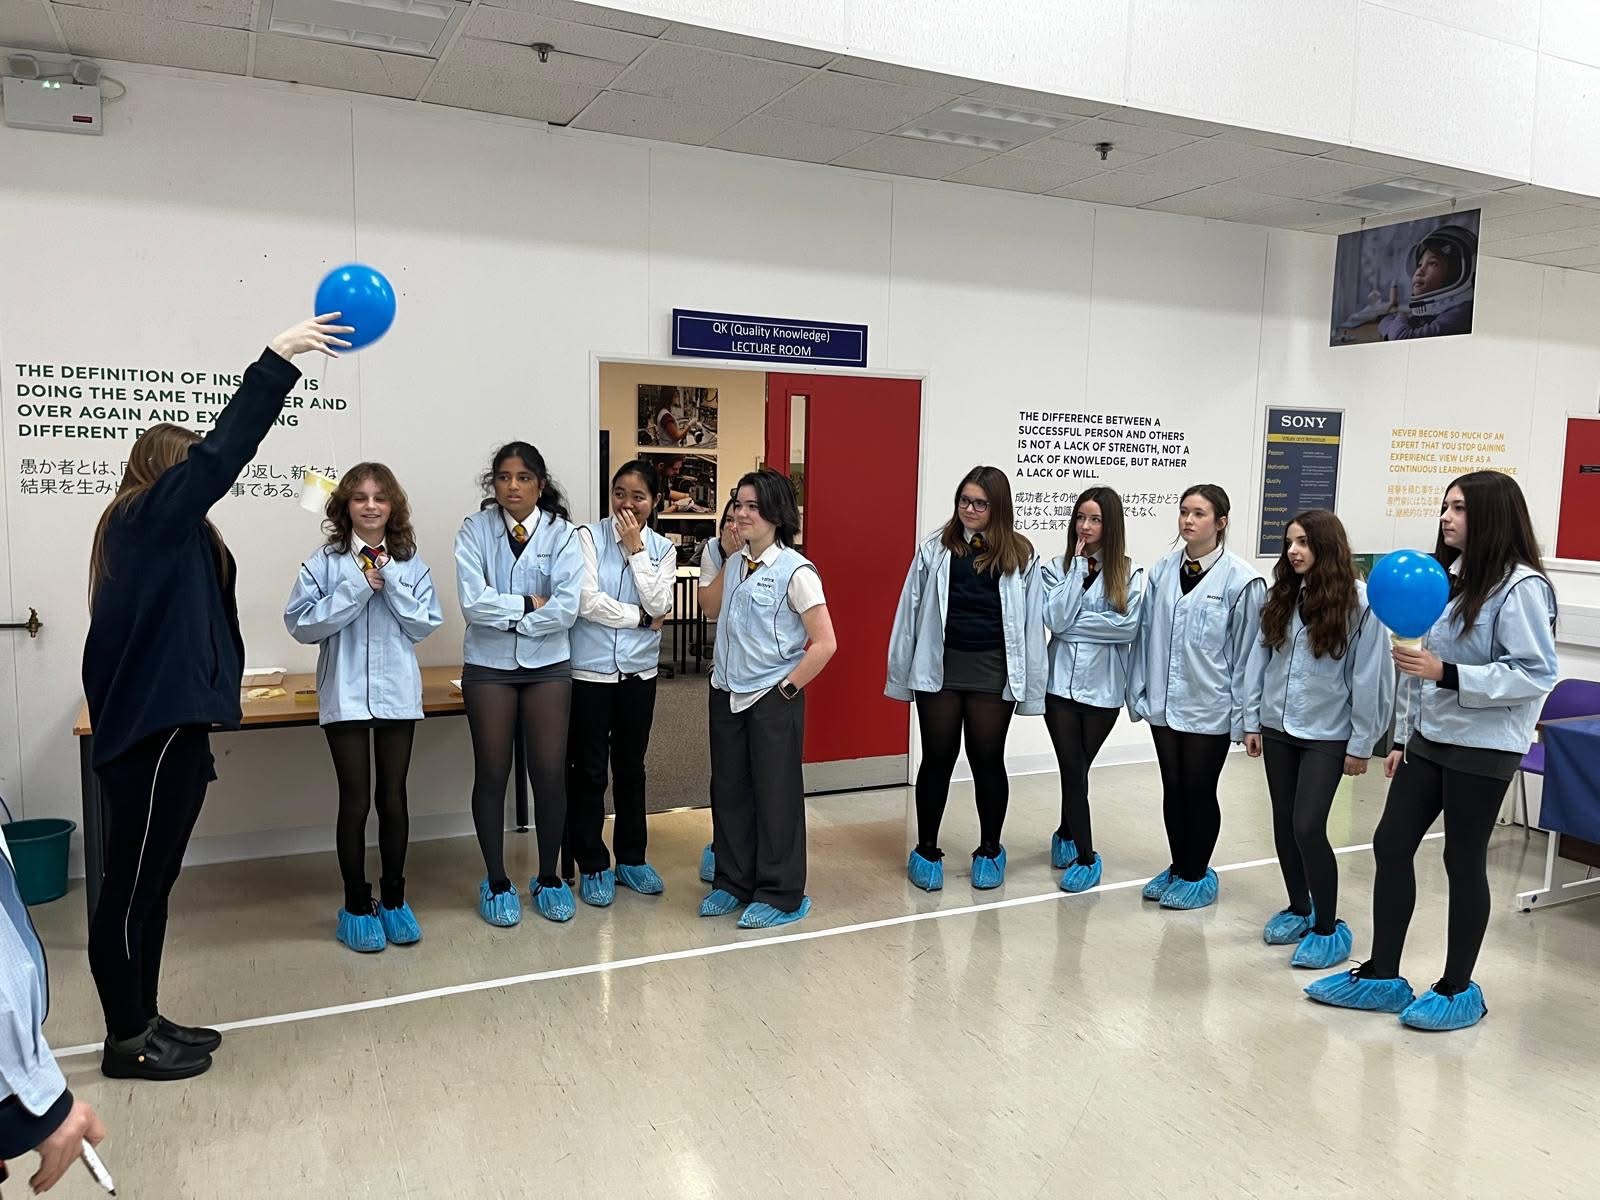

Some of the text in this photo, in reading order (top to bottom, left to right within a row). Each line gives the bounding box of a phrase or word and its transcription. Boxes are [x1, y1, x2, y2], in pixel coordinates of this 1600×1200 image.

[712, 322, 831, 343] QK (Quality Knowledge)
[731, 341, 812, 357] LECTURE ROOM
[16, 364, 54, 377] THE
[61, 365, 174, 383] DEFINITION
[180, 371, 206, 385] OF
[304, 378, 319, 391] IS
[17, 384, 347, 411] DOING THE SAME THIN ER AND
[17, 404, 72, 418] OVER
[79, 406, 141, 420] AGAIN
[149, 408, 189, 423] AND
[1019, 411, 1161, 427] THE DIFFERENCE BETWEEN A
[1281, 415, 1327, 428] SONY
[18, 424, 129, 440] DIFFERENT
[1018, 426, 1185, 441] SUCCESSFUL PERSON AND OTHERS
[1392, 429, 1417, 437] NEVER
[1418, 430, 1448, 438] BECOME
[1461, 432, 1481, 440] MUCH
[1483, 432, 1493, 440] OF
[1494, 432, 1504, 440] AN
[1018, 440, 1190, 455] IS NOT A LACK OF STRENGTH, NOT A
[1391, 441, 1506, 452] EXPERT THAT YOU STOP GAINING
[1017, 454, 1187, 468] LACK OF KNOWLEDGE, BUT RATHER
[1390, 453, 1436, 462] EXPERIENCE.
[1439, 454, 1457, 462] VIEW
[1475, 455, 1485, 463] AS
[1486, 455, 1492, 463] A
[1016, 468, 1099, 479] A LACK OF WILL.
[1389, 465, 1437, 473] CONTINUOUS
[1439, 466, 1474, 474] LEARNING
